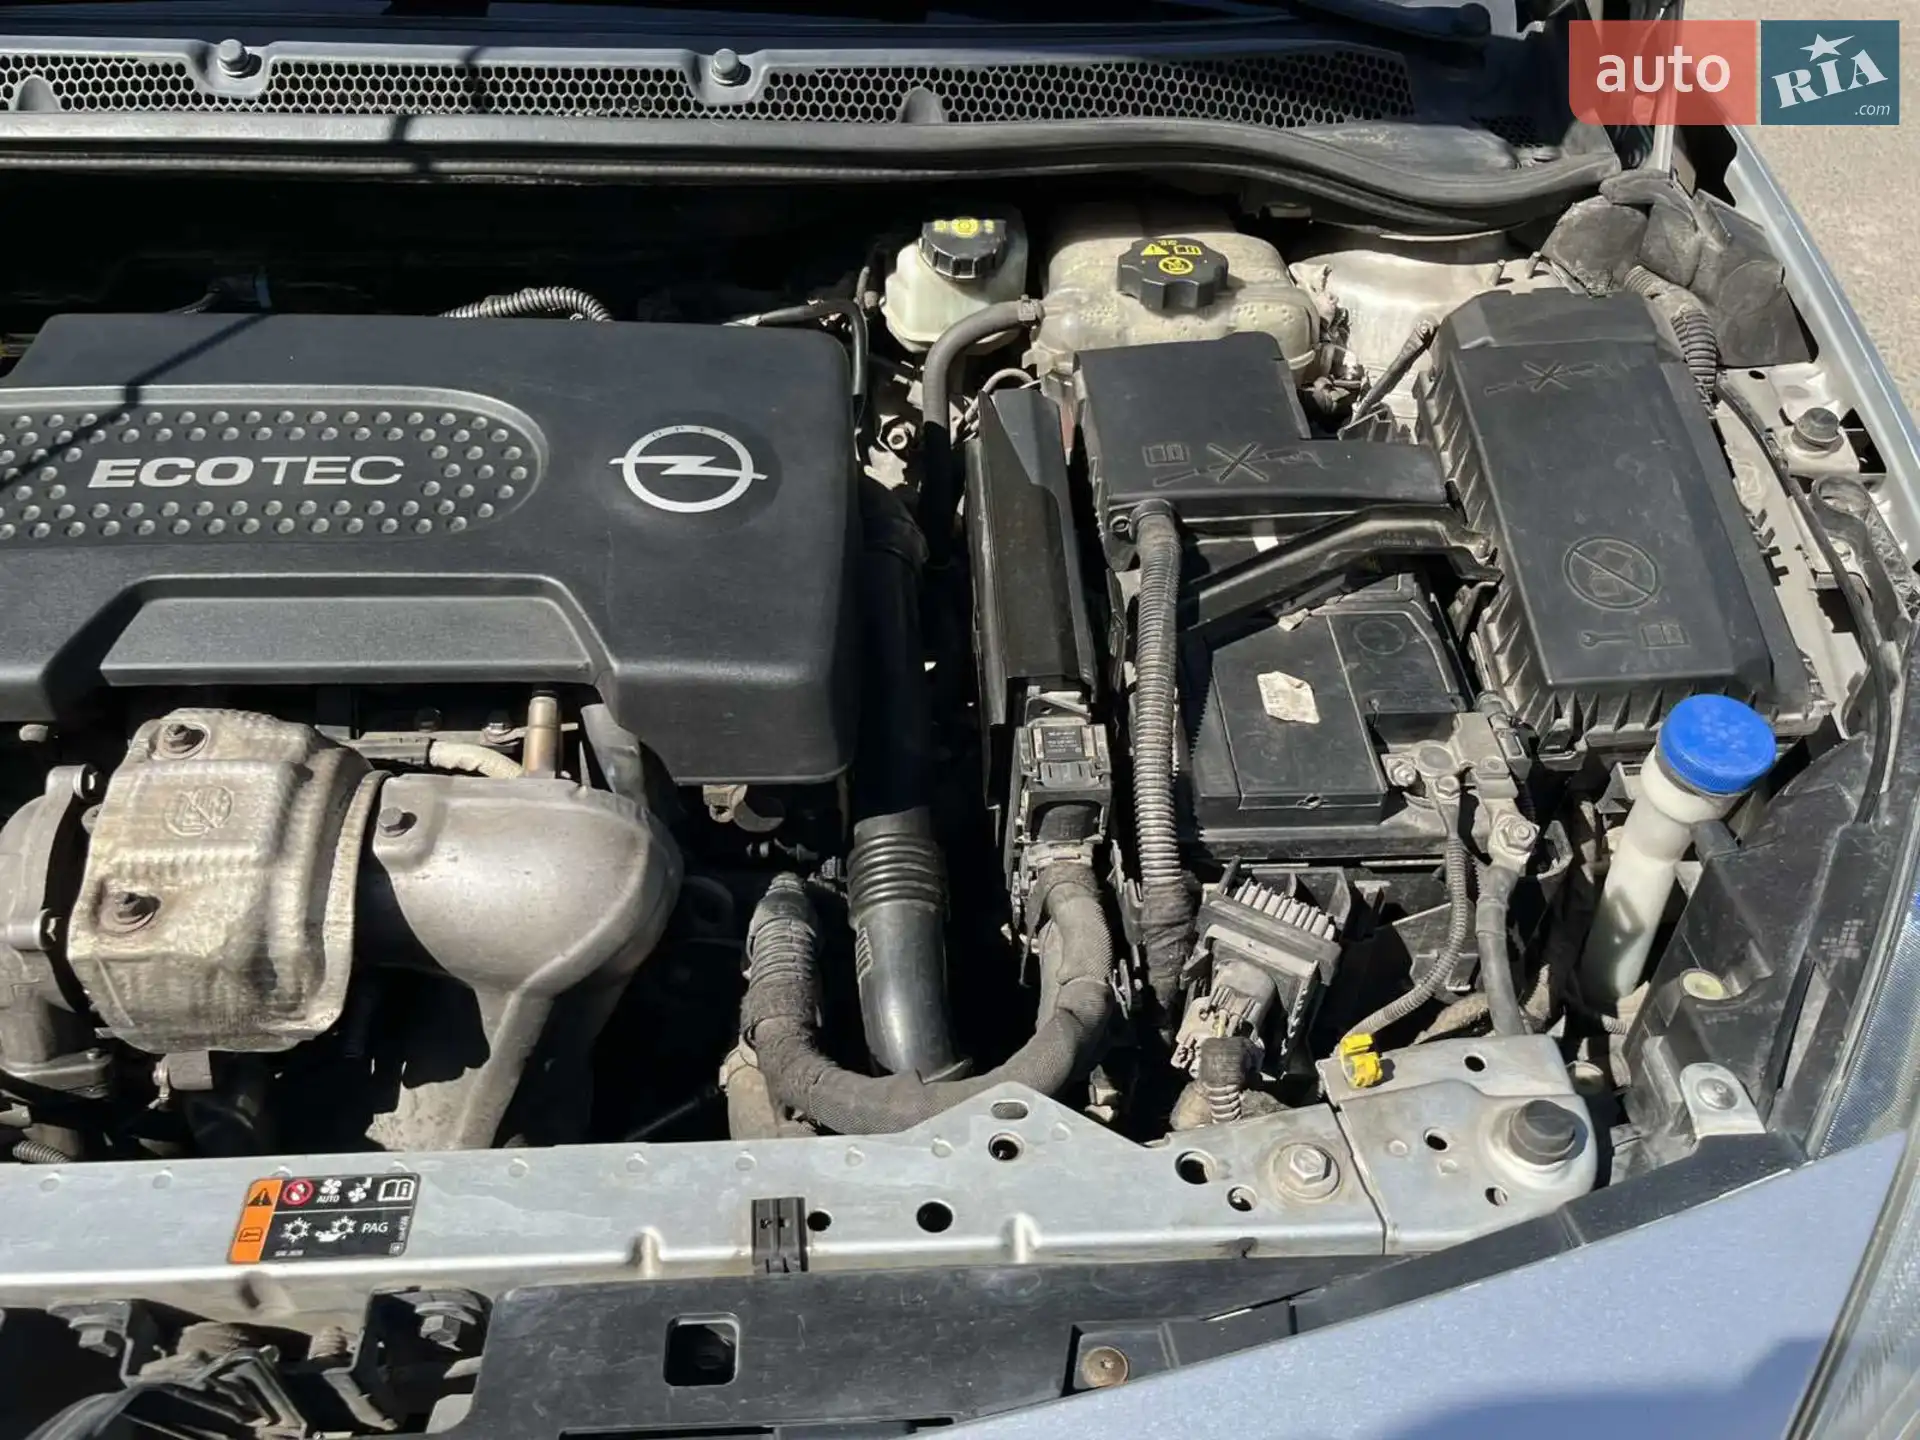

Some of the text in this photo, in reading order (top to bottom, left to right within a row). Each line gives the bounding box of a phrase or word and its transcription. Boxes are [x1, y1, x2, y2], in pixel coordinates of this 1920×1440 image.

[87, 455, 404, 488] ECOTEC
[316, 1194, 340, 1203] AUTO
[361, 1221, 389, 1234] PAG
